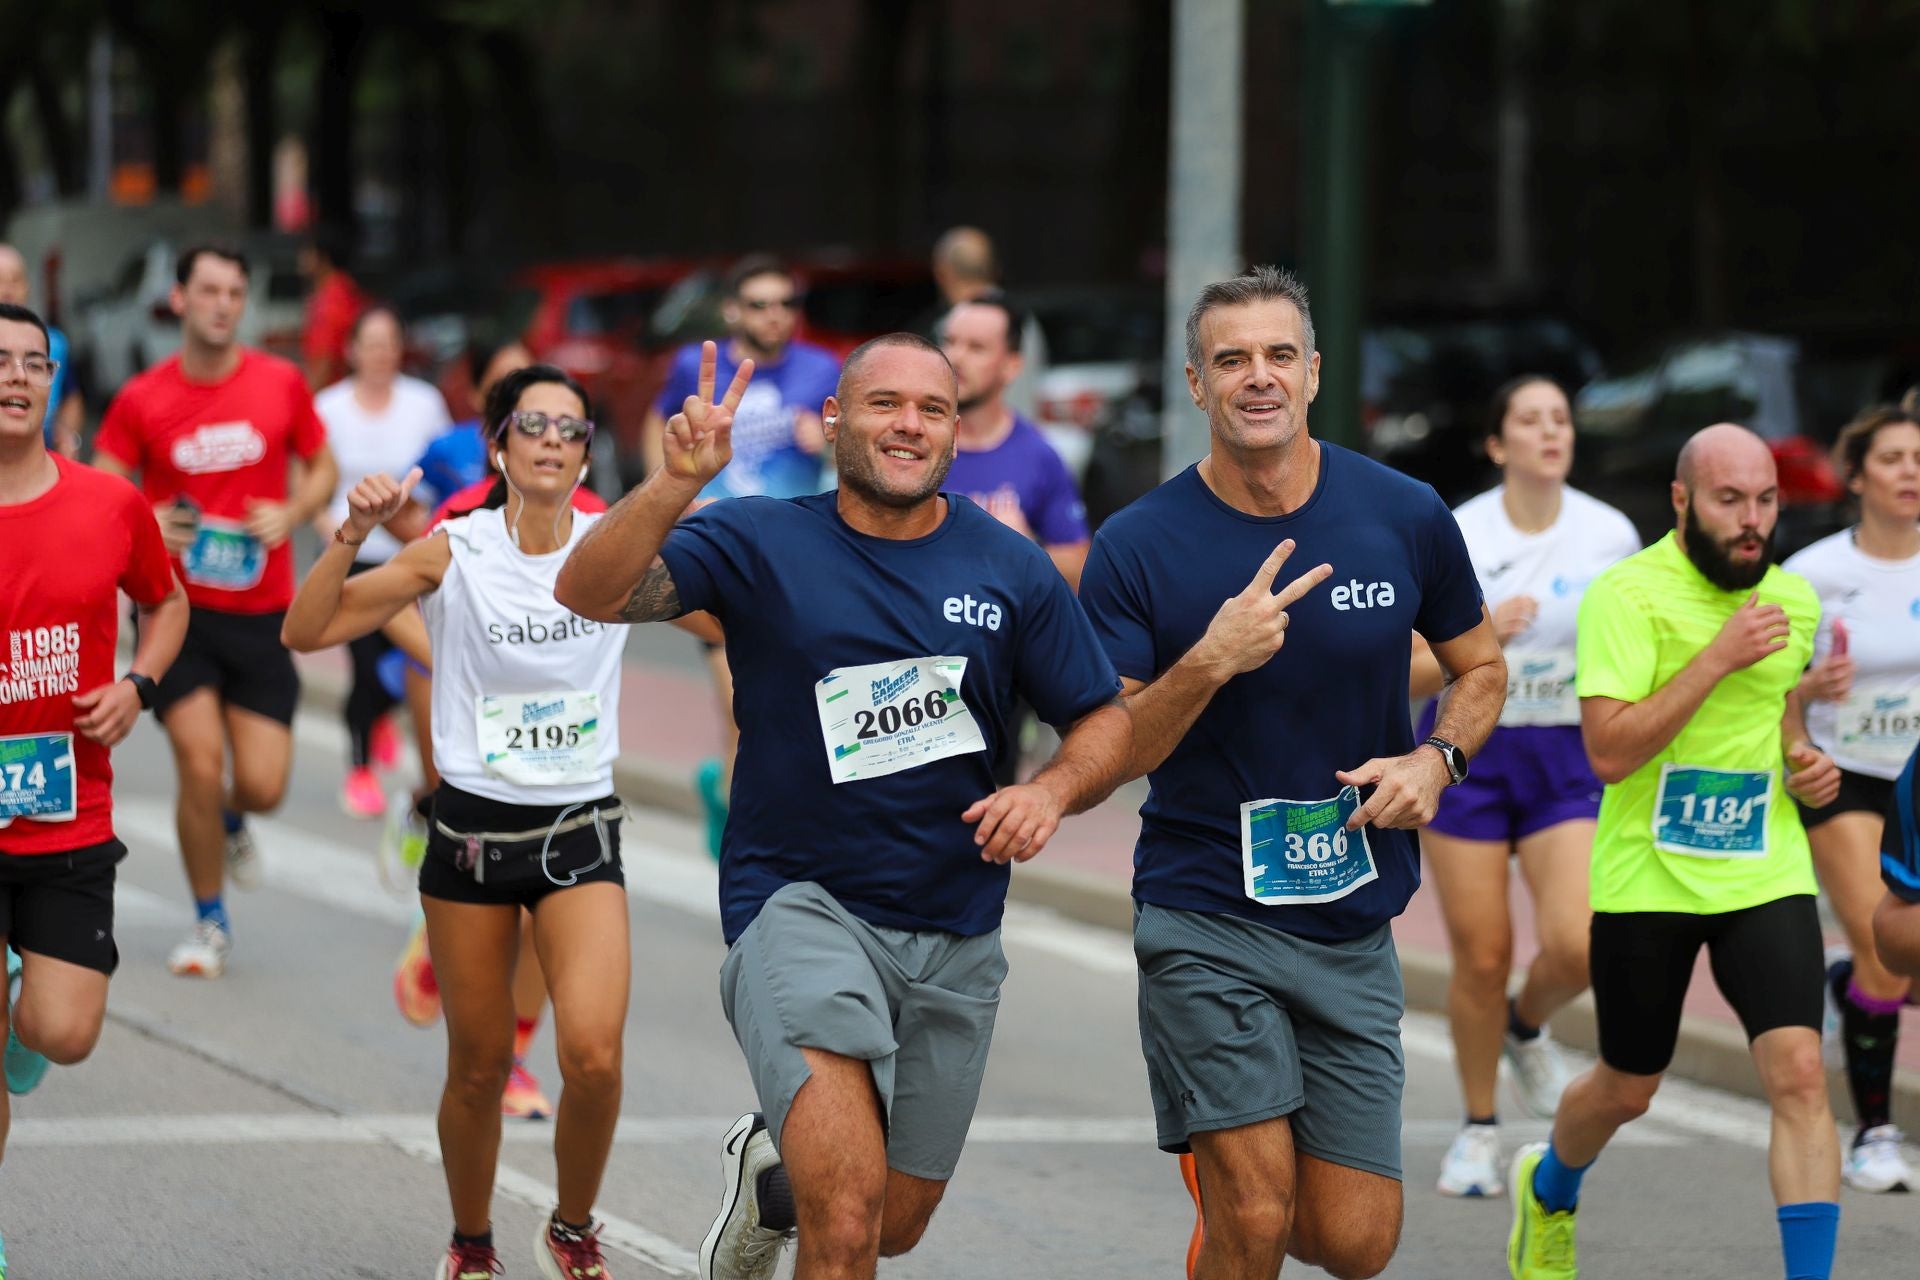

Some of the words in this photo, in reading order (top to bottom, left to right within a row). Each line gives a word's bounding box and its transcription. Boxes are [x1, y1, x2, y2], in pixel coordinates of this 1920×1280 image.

[1331, 579, 1395, 610] etra
[943, 594, 1002, 631] etra
[22, 622, 80, 659] 1985
[488, 613, 607, 644] sabate
[11, 652, 80, 680] SUMANDO
[872, 666, 918, 700] CARRERA
[854, 689, 948, 740] 2066
[506, 725, 579, 749] 2195
[897, 735, 916, 746] ETRA
[1680, 793, 1753, 825] 1134
[1285, 827, 1348, 863] 366
[1309, 869, 1328, 877] ETRA
[1330, 867, 1335, 875] 3
